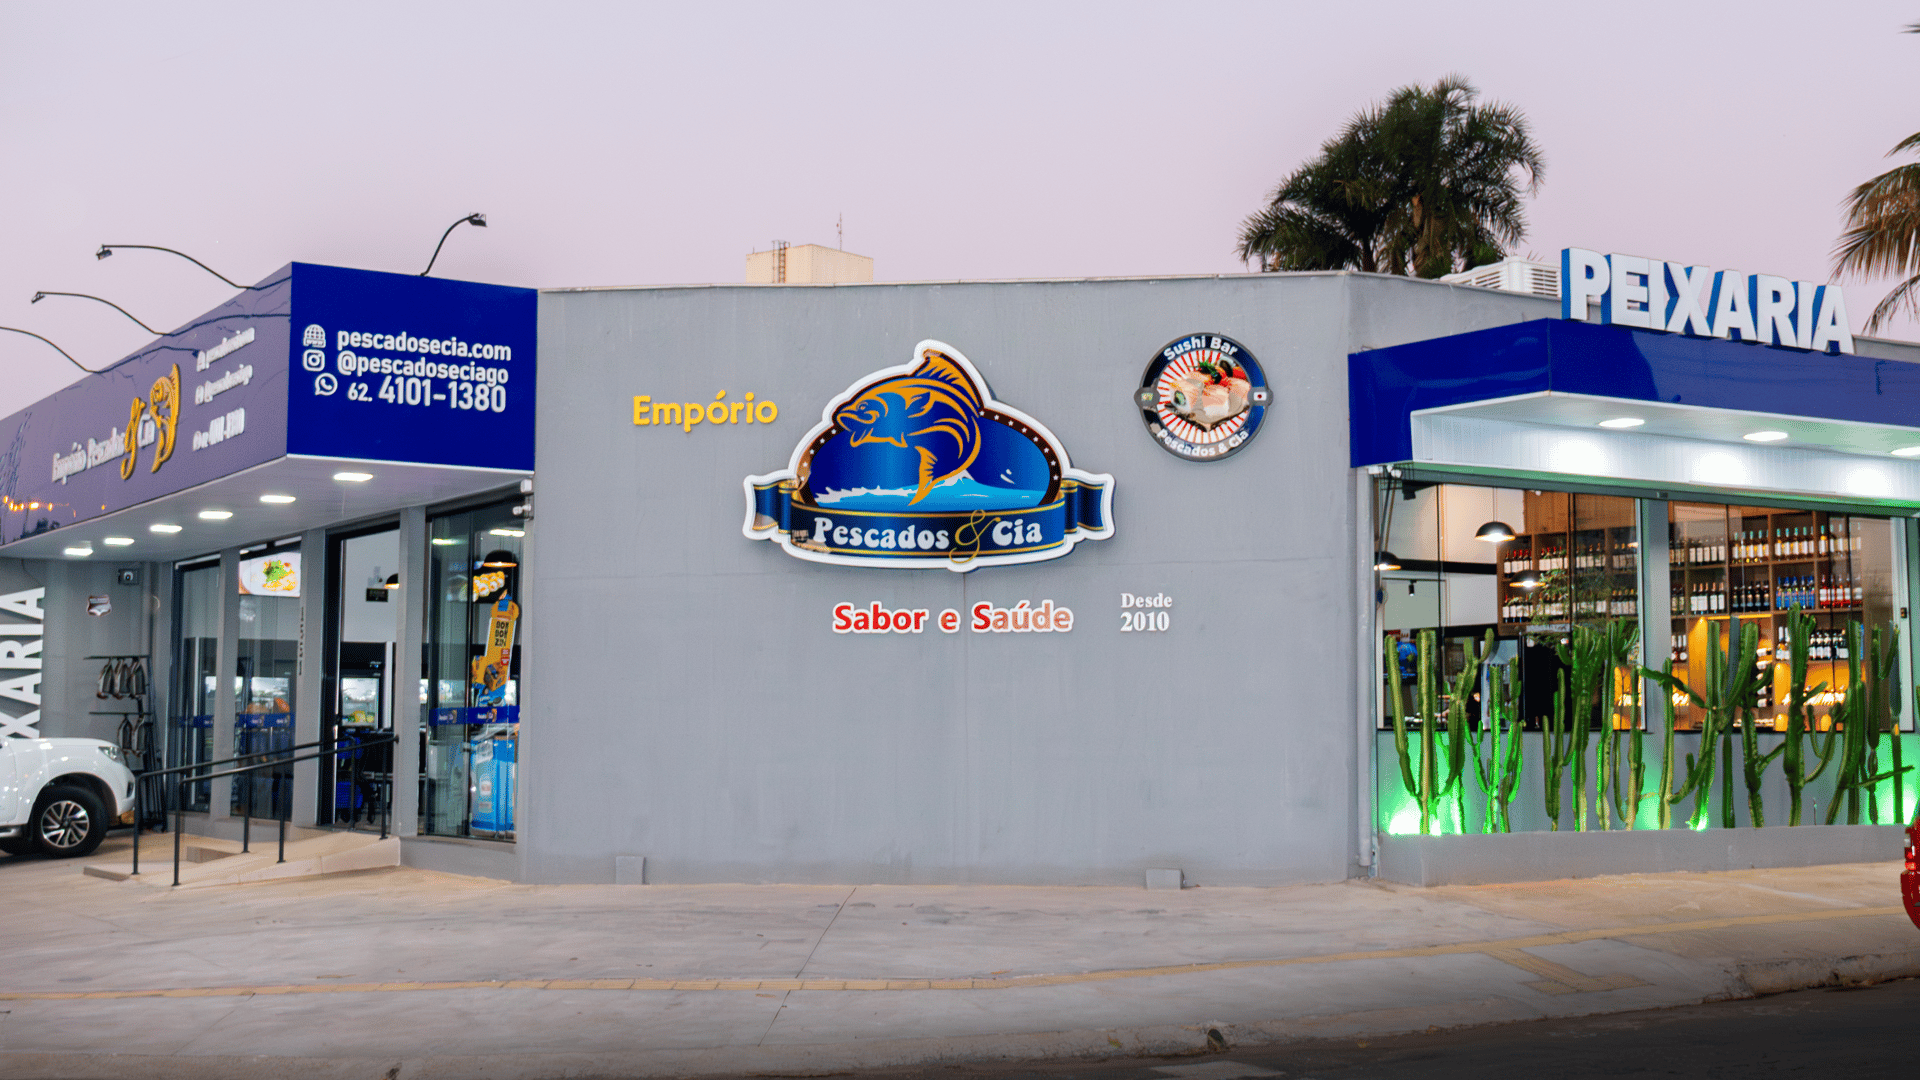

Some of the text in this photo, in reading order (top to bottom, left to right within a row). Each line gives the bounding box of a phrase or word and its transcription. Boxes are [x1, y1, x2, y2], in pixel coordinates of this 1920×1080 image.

[1562, 247, 1855, 355] PEIXARIA
[337, 331, 512, 362] pescadosecia.com
[1163, 335, 1239, 360] Sushi Bar
[337, 350, 509, 386] @pescadoseciago
[347, 375, 507, 413] 62. 4101-1380
[633, 391, 778, 433] Empório
[1157, 428, 1215, 457] Pescados
[1218, 442, 1228, 454] &
[813, 516, 949, 550] Pescados
[991, 517, 1042, 545] Cia
[833, 599, 1074, 633] Sabor e Saúde
[1120, 592, 1173, 608] Desde
[1120, 611, 1170, 632] 2010
